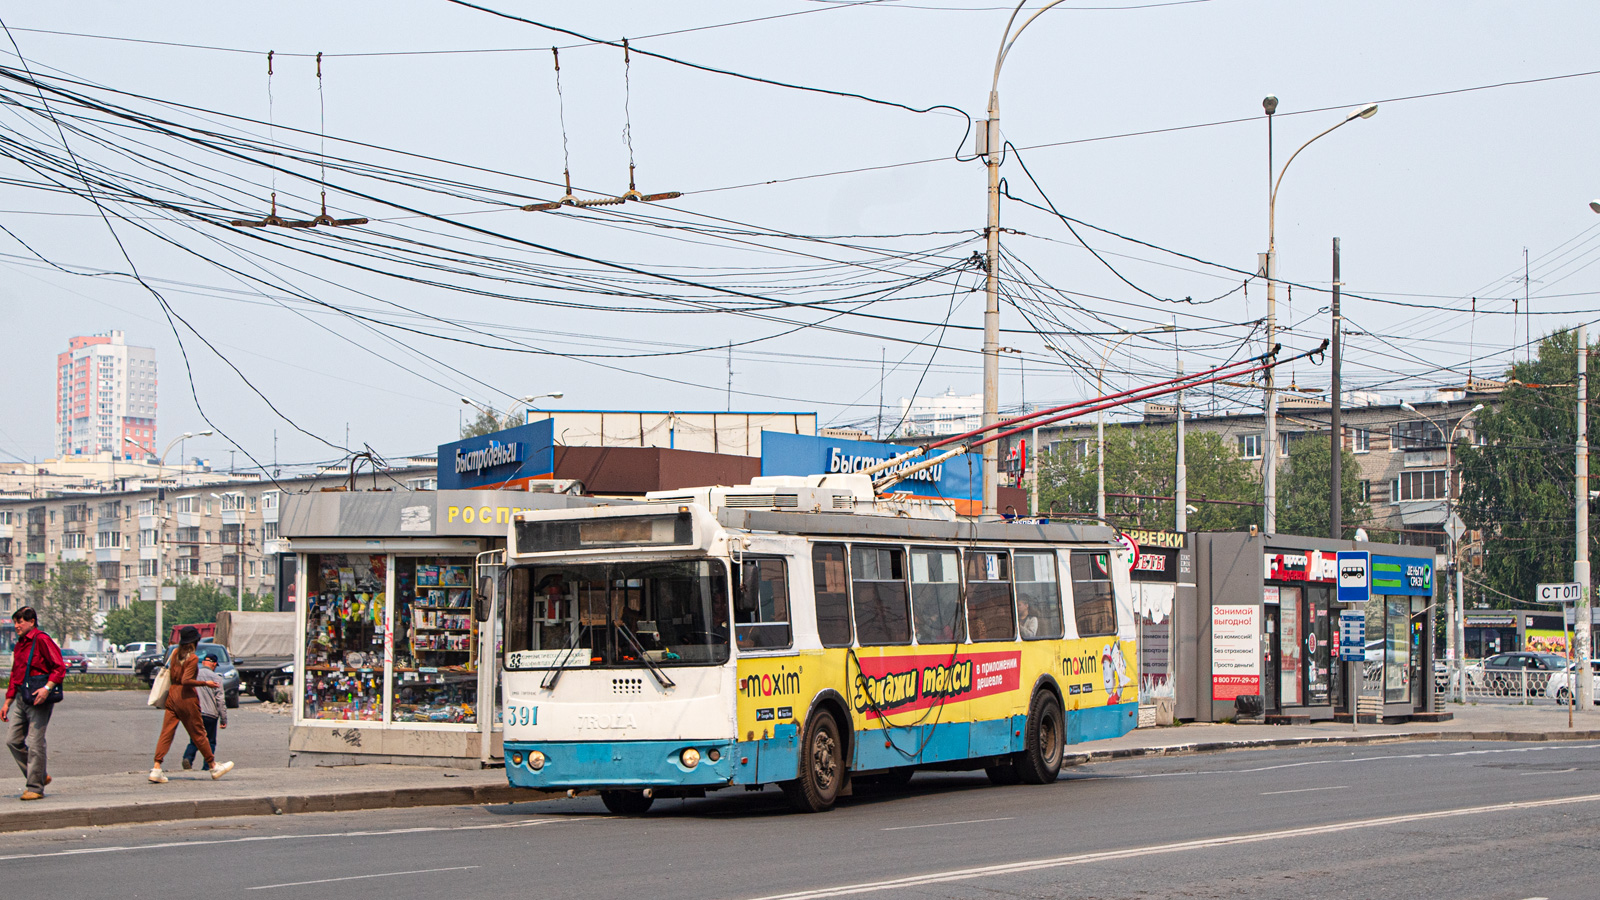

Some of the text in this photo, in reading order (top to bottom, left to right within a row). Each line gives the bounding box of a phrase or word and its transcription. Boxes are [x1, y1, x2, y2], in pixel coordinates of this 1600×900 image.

[455, 440, 517, 476] Быстроденьги
[448, 506, 526, 524] РОСП
[1541, 585, 1578, 599] СТОП
[1213, 606, 1253, 616] Занимай
[1213, 617, 1252, 626] выгодно!
[976, 657, 1017, 676] в приложении
[1062, 650, 1097, 676] maxim
[747, 665, 800, 698] maxim
[854, 668, 918, 714] Закажи
[976, 674, 1003, 691] дешевле
[508, 705, 539, 726] 391
